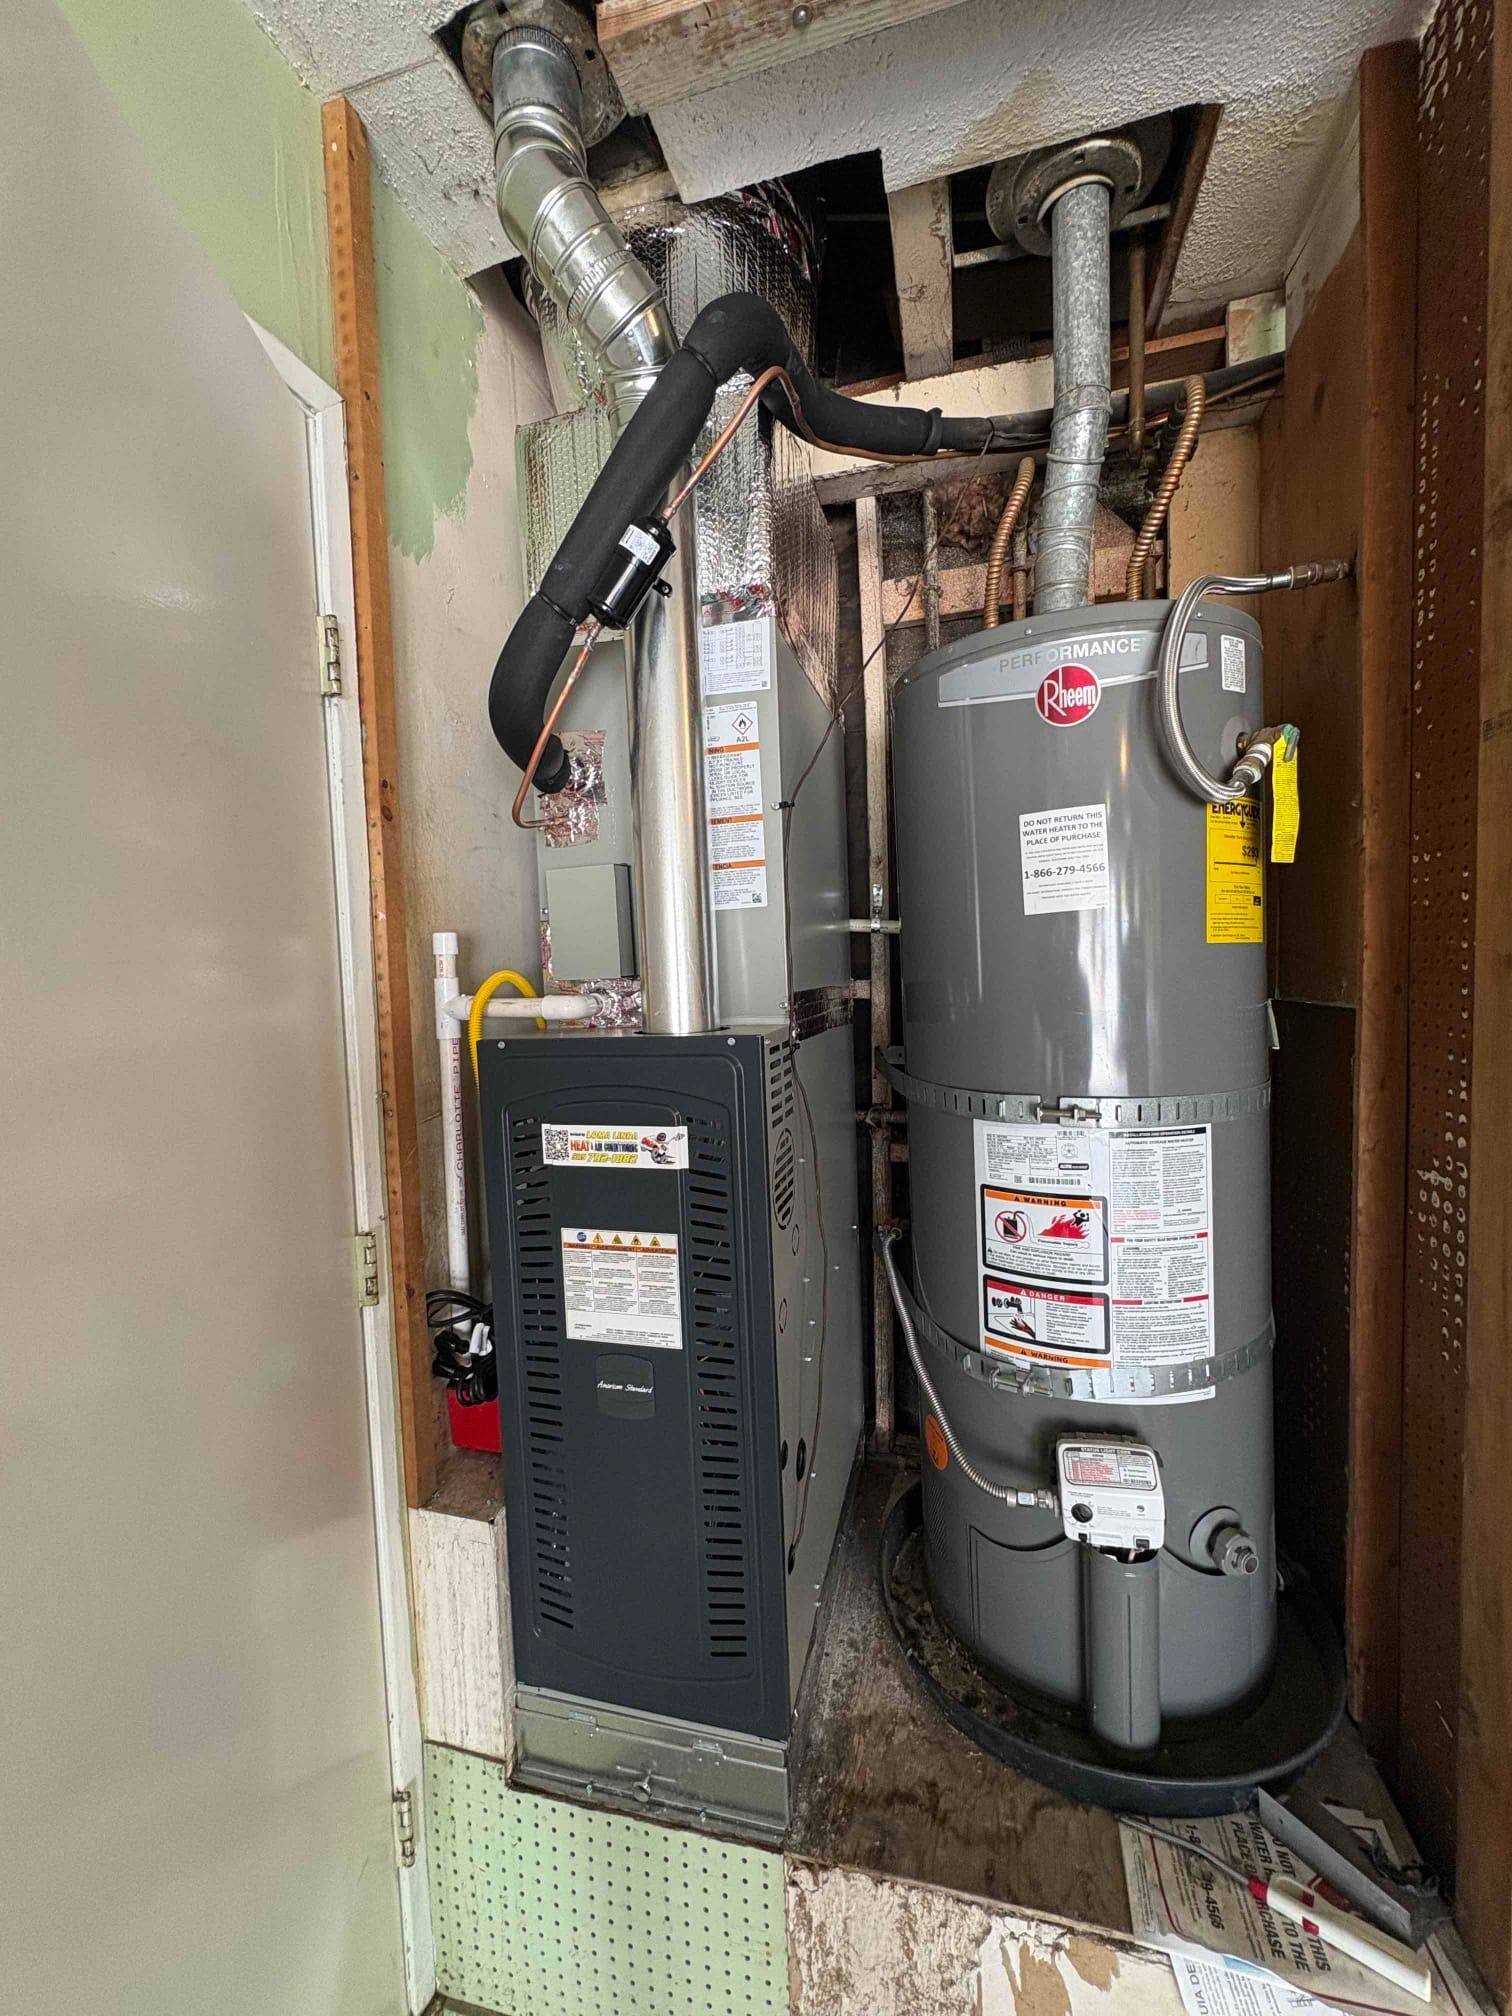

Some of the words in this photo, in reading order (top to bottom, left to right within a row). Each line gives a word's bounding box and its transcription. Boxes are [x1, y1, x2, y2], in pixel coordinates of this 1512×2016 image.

[1000, 637, 1141, 672] PERFORMANCE
[1043, 667, 1096, 717] Rheem
[736, 735, 750, 743] A2L
[1022, 828, 1048, 837] WATER
[1049, 824, 1077, 833] HEATER
[1078, 822, 1089, 830] TO
[1090, 820, 1103, 829] THE
[1023, 820, 1035, 828] DO
[1036, 817, 1052, 826] NOT
[1054, 814, 1084, 823] RETURN
[1085, 811, 1103, 820] THIS
[1026, 837, 1048, 846] PLACE
[1061, 831, 1101, 842] PURCHASE
[1024, 862, 1106, 880] 1-866-279-4566
[451, 1038, 460, 1074] PIPE
[453, 1084, 464, 1171] CHARLOTTE
[570, 1140, 590, 1152] HEAT
[1023, 1196, 1067, 1208] WARNING
[1028, 1290, 1067, 1302] DANGER
[1030, 1351, 1069, 1364] WARNING
[1249, 1821, 1271, 1865] WATER
[1230, 1820, 1252, 1863] PLACE
[1256, 1899, 1286, 1960] RCHASE
[1279, 1854, 1297, 1878] NOT
[1307, 1935, 1331, 1973] THIS
[1281, 1919, 1299, 1938] TO
[1289, 1941, 1311, 1973] THE
[1194, 1990, 1209, 2016] UIA
